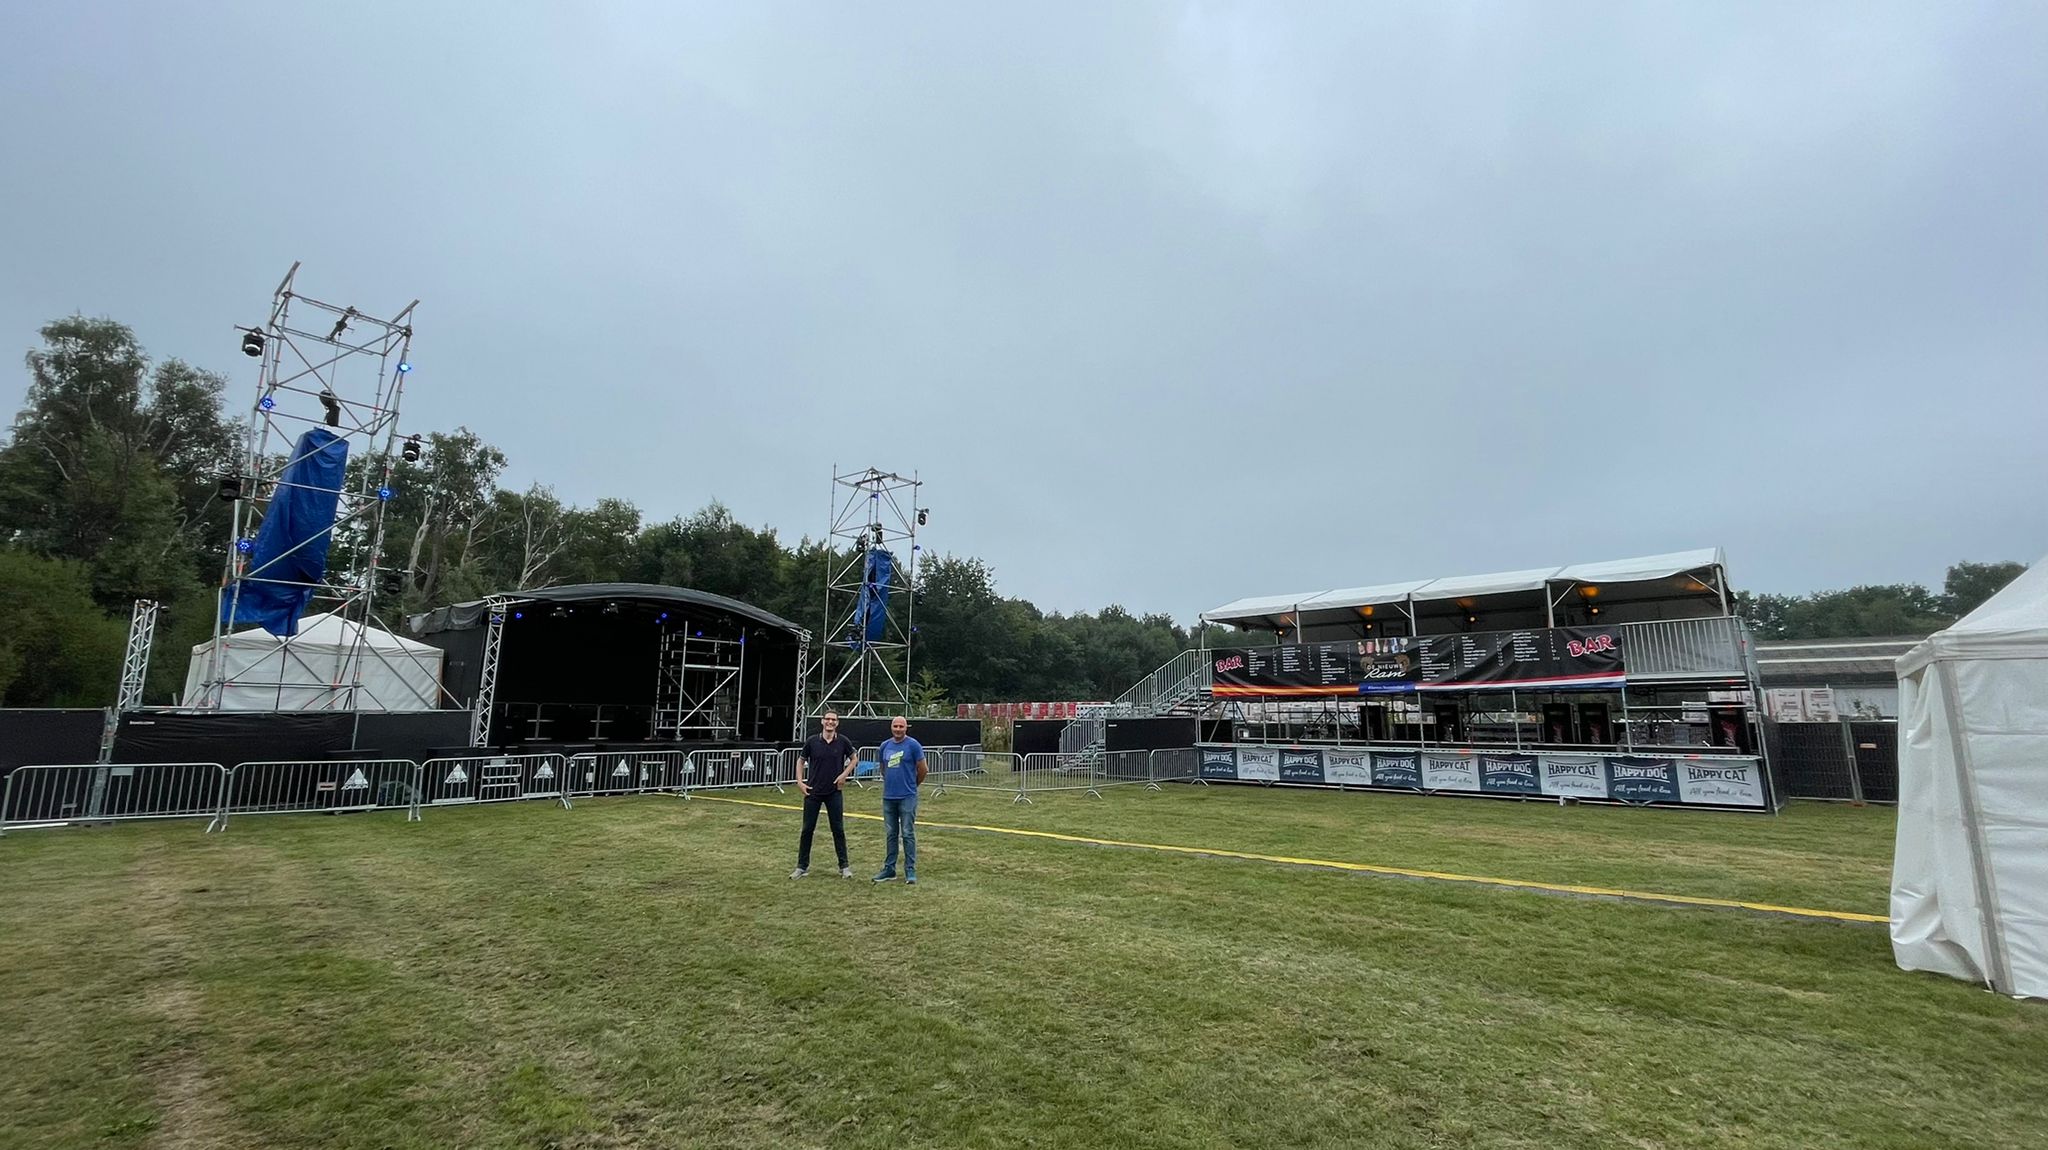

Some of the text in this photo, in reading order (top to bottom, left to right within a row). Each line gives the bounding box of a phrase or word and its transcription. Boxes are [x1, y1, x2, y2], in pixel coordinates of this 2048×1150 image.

[1567, 634, 1616, 657] BAR
[1215, 655, 1243, 673] BAR
[1364, 668, 1406, 679] Ram
[1204, 753, 1232, 762] HAPPY DOG
[1262, 755, 1273, 763] CAT
[1284, 756, 1317, 765] HAPPY DOG
[1329, 756, 1363, 766] HAPPY CAT
[1377, 758, 1415, 769] HAPPY DOG
[1430, 760, 1470, 770] HAPPY CAT
[1486, 761, 1532, 773] HAPPY DOG
[1548, 764, 1597, 775] HAPPY CAT
[1613, 766, 1668, 779] HAPPY DOG
[1688, 768, 1747, 781] HAPPY CAT
